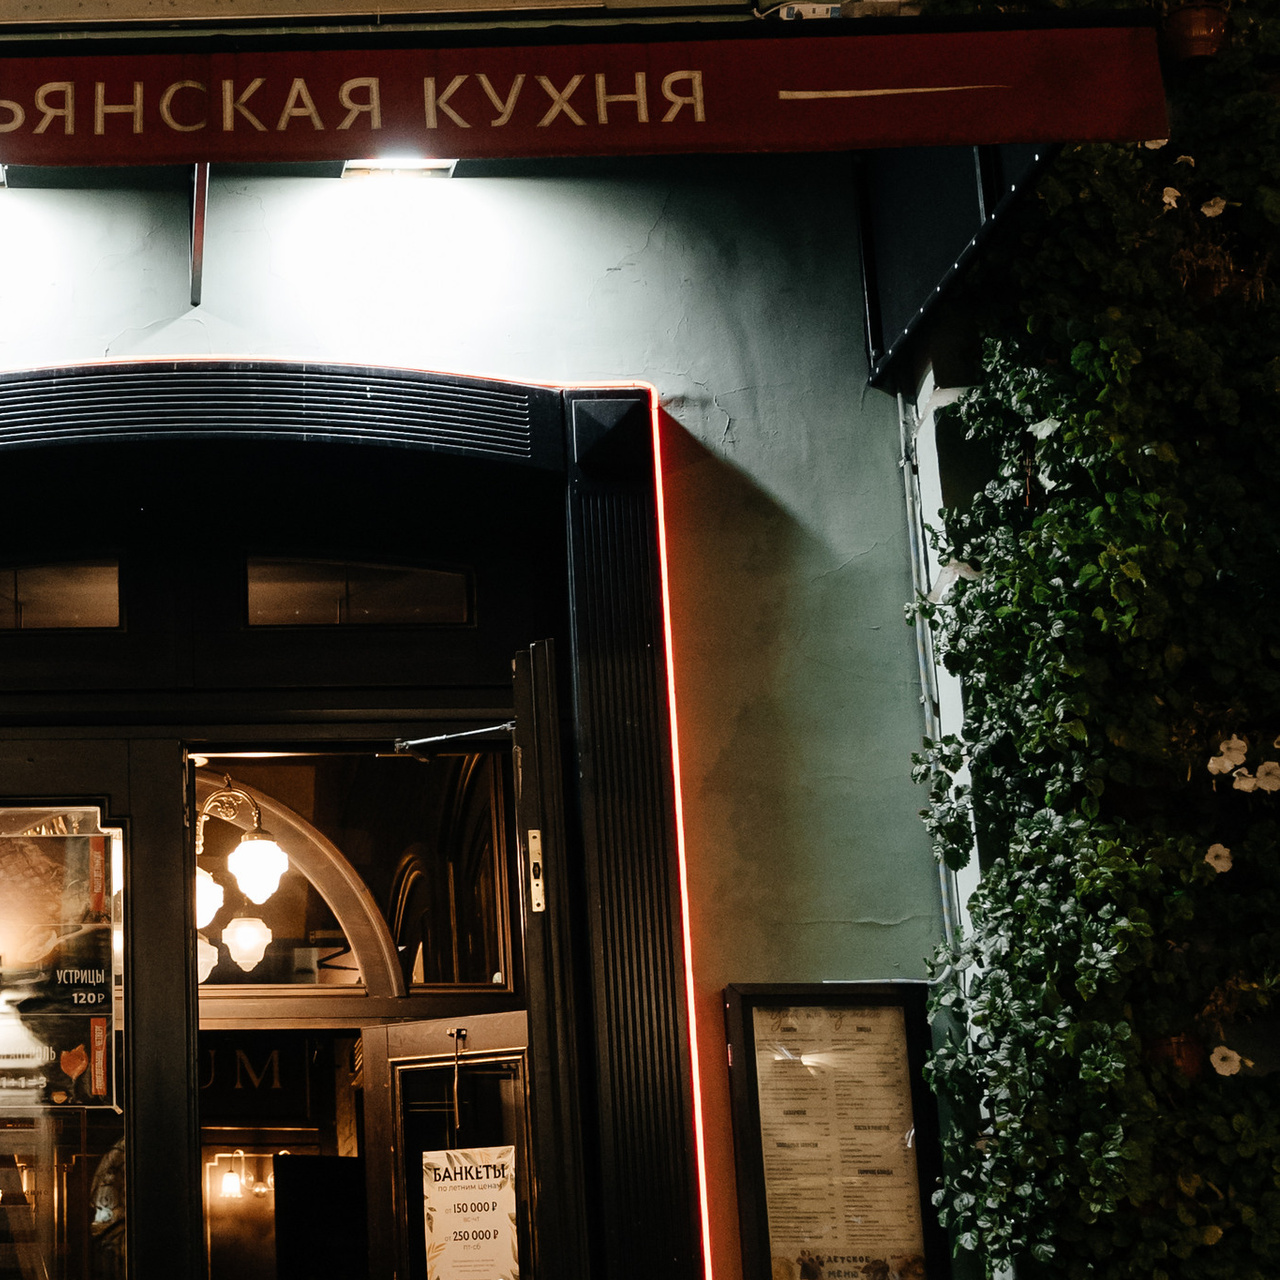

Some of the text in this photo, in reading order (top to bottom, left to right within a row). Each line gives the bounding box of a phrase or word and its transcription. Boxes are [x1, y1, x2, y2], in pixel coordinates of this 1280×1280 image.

[423, 70, 706, 129] КУХНЯ
[56, 969, 105, 986] УСТРИЦЫ
[433, 1163, 506, 1183] БАНКЕТЫ
[453, 1202, 468, 1213] 150
[470, 1201, 490, 1212] 000
[452, 1230, 470, 1241] 250
[471, 1229, 491, 1240] 000
[826, 1255, 871, 1264] ДЕТСКОЕ
[827, 1270, 859, 1278] МЕНЮ
